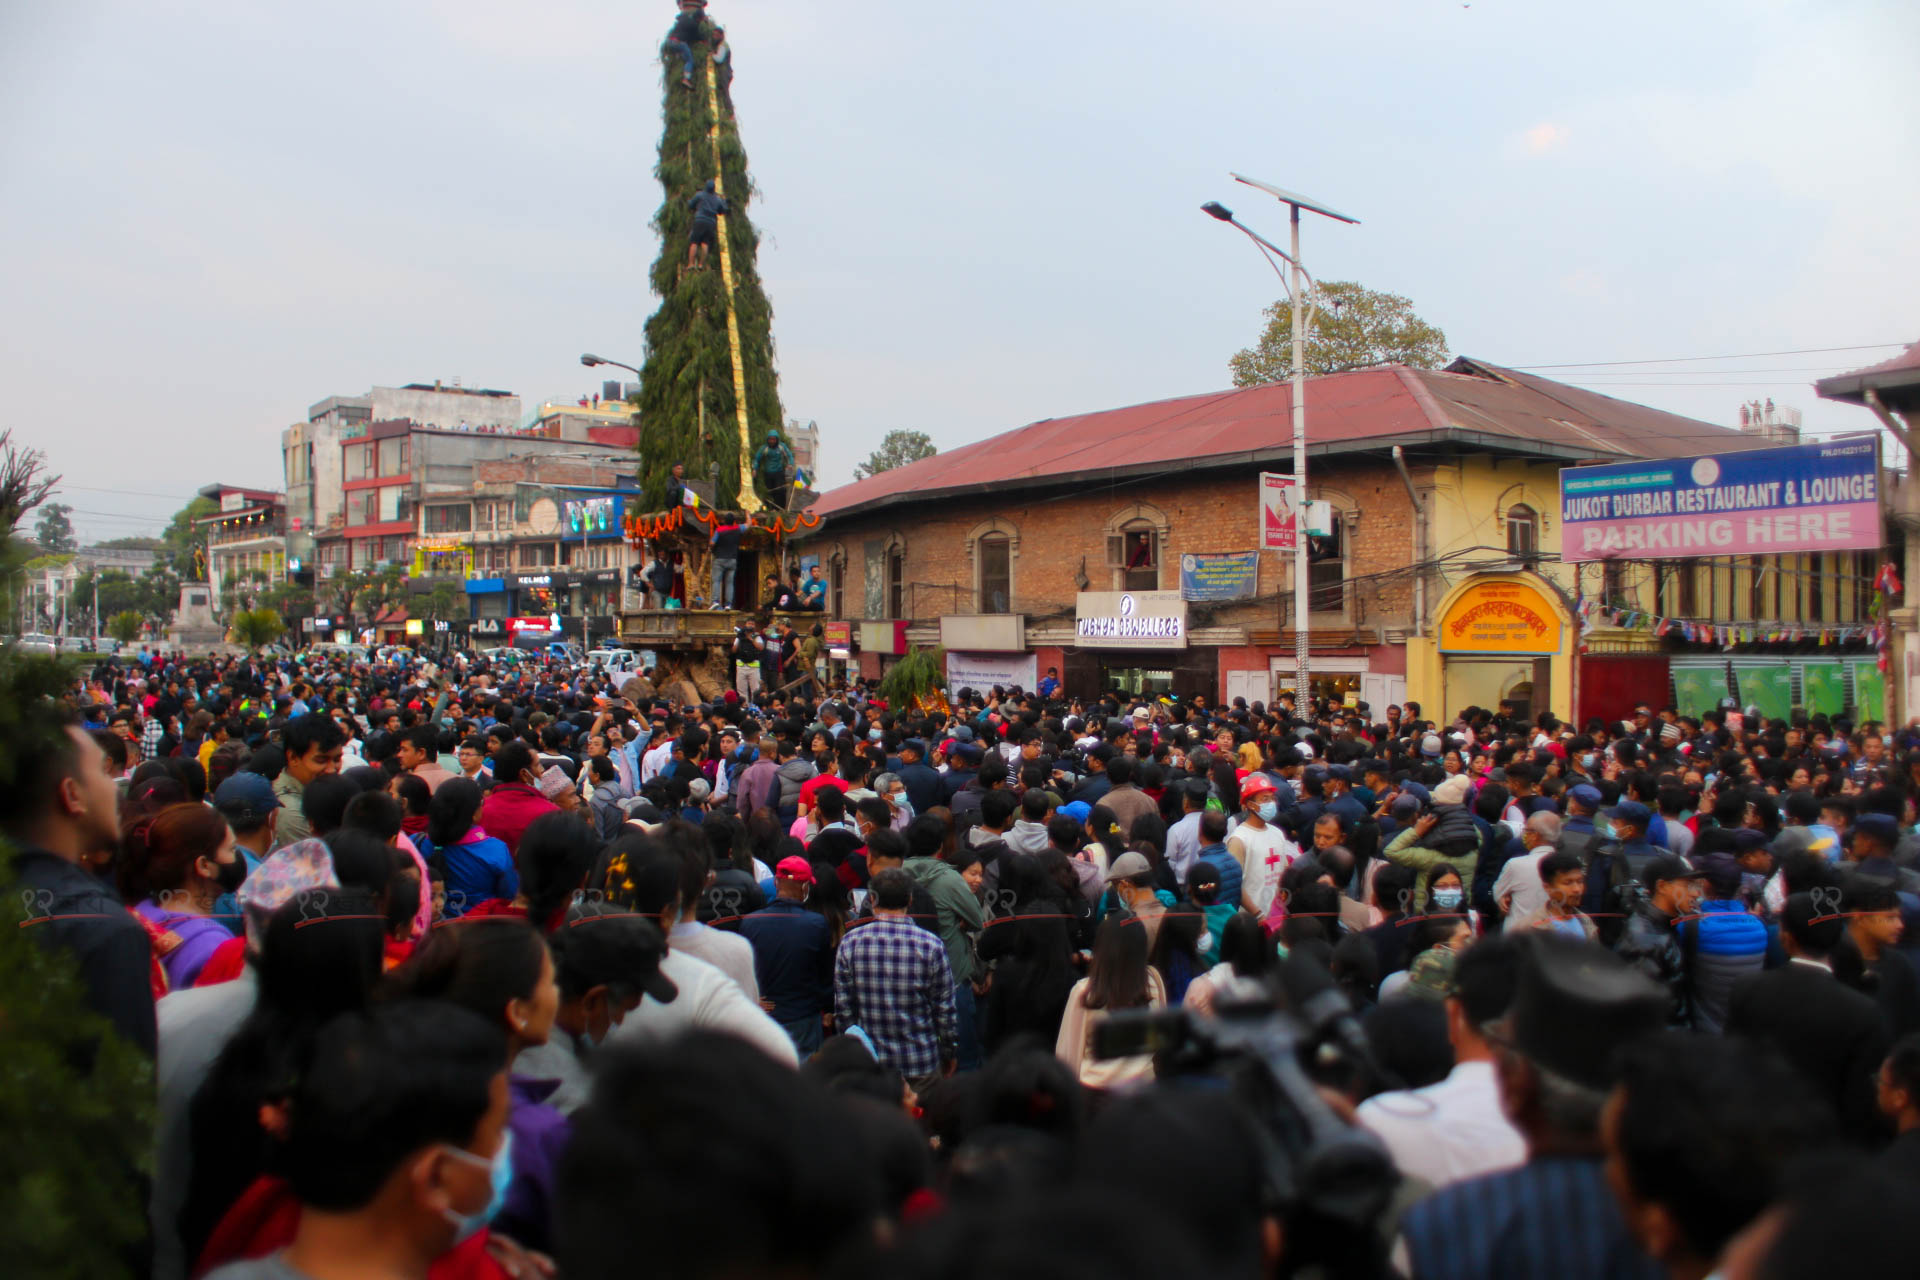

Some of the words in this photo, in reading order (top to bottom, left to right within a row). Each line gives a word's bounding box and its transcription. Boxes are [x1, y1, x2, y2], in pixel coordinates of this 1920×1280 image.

[1563, 496, 1609, 521] JUKOT
[1613, 491, 1672, 517] DURBAR
[1676, 482, 1780, 514] RESTAURANT
[1785, 481, 1796, 505] &
[1802, 474, 1876, 504] LOUNGE
[1583, 519, 1734, 552] PARKING
[1746, 511, 1854, 544] HERE
[469, 619, 499, 633] FILA
[1119, 617, 1179, 636] JEWELLERS
